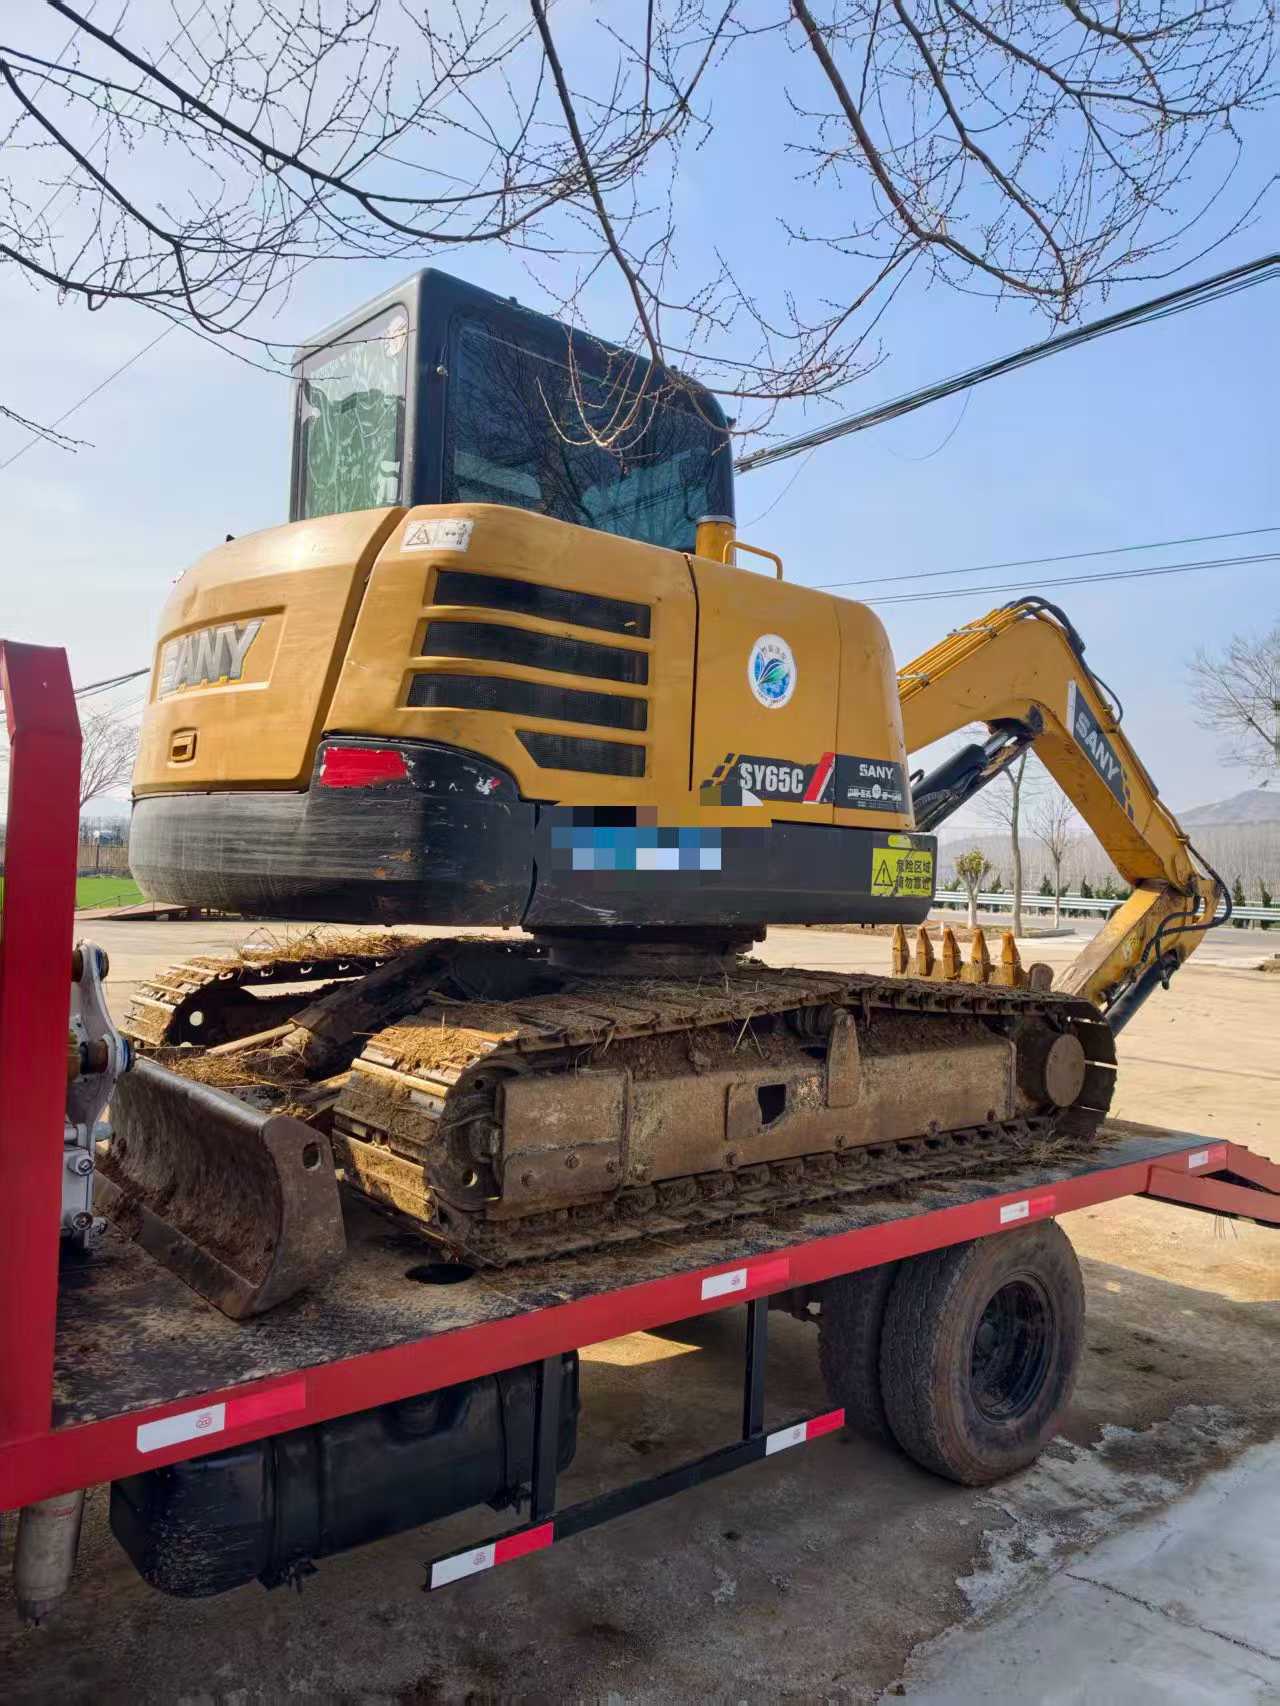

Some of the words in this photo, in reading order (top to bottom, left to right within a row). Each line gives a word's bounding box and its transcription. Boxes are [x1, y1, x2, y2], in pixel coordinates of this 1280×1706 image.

[1075, 711, 1120, 781] SANY
[740, 762, 804, 794] SY65C
[859, 763, 894, 779] SANY
[896, 859, 931, 873] 危险区域
